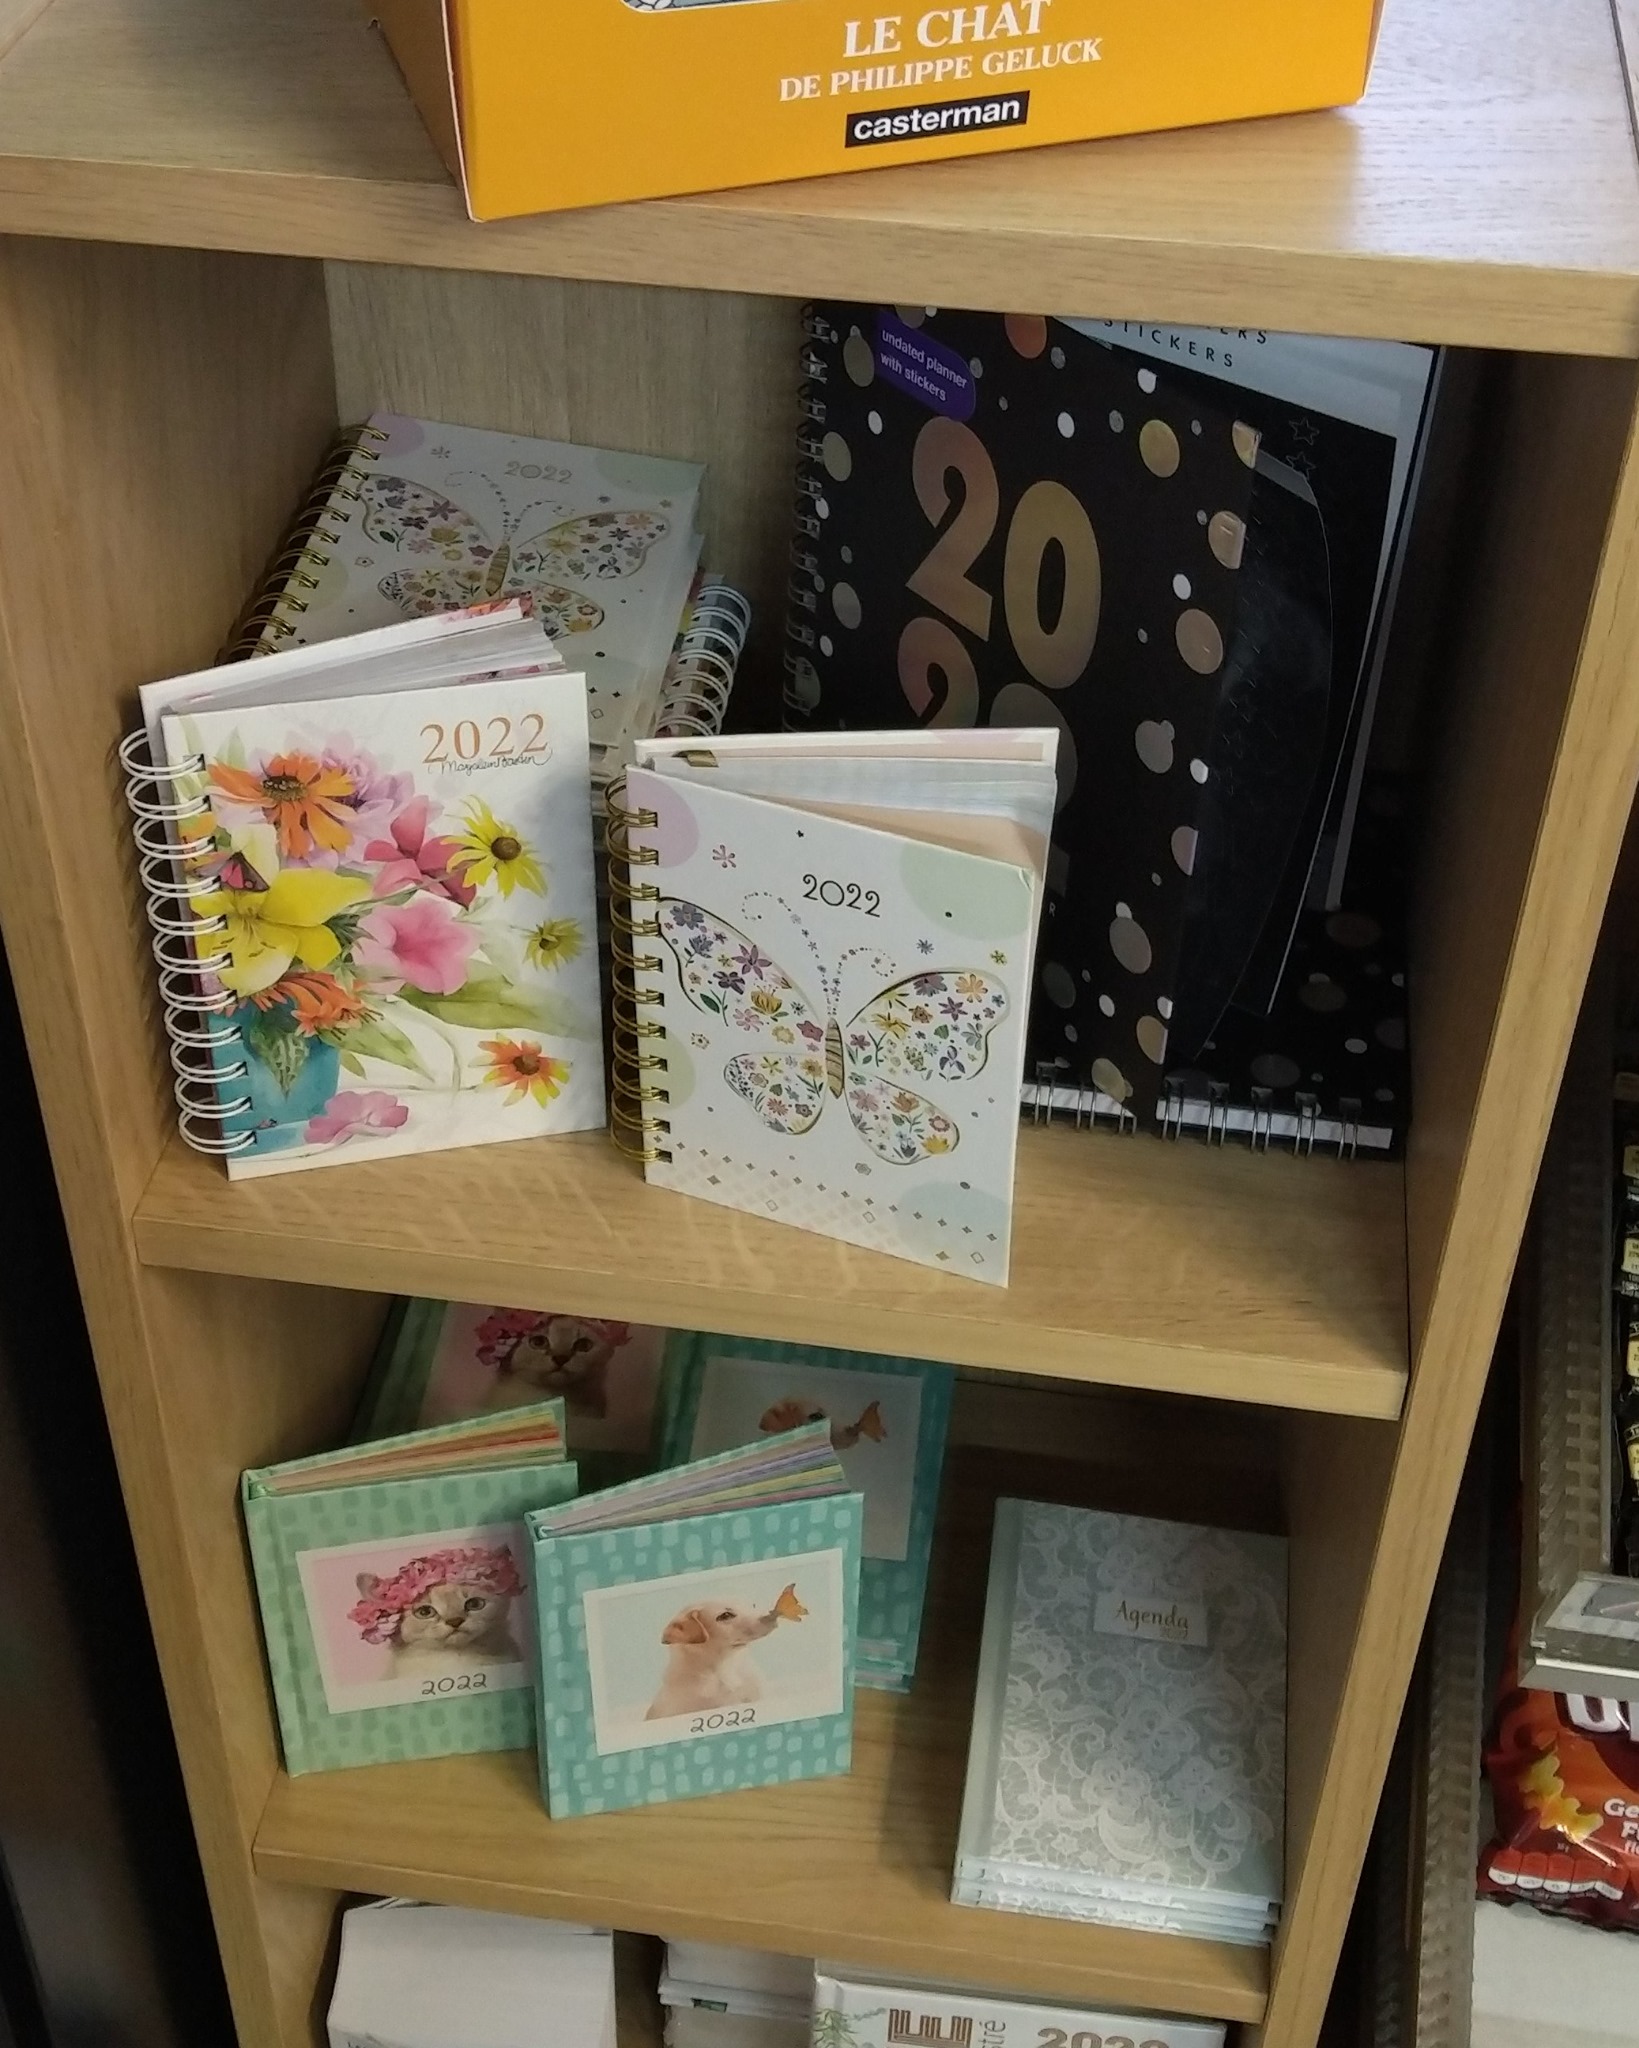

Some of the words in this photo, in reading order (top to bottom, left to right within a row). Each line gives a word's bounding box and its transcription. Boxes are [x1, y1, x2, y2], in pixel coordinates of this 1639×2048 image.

[843, 16, 902, 57] LE
[916, 0, 1050, 48] CHAT
[780, 75, 821, 101] DE
[829, 55, 973, 96] PHILIPPE
[981, 38, 1103, 76] GELUCK
[853, 99, 1020, 140] casterman
[881, 353, 902, 374] with
[905, 368, 946, 401] stickers
[882, 330, 924, 363] undated
[926, 357, 967, 388] planner
[504, 461, 572, 484] 2022
[906, 416, 1101, 689] 20
[420, 713, 548, 764] 2022
[803, 873, 881, 918] 2022
[1115, 1600, 1188, 1632] Agenda
[421, 1672, 487, 1695] 2022
[690, 1708, 755, 1732] 2022
